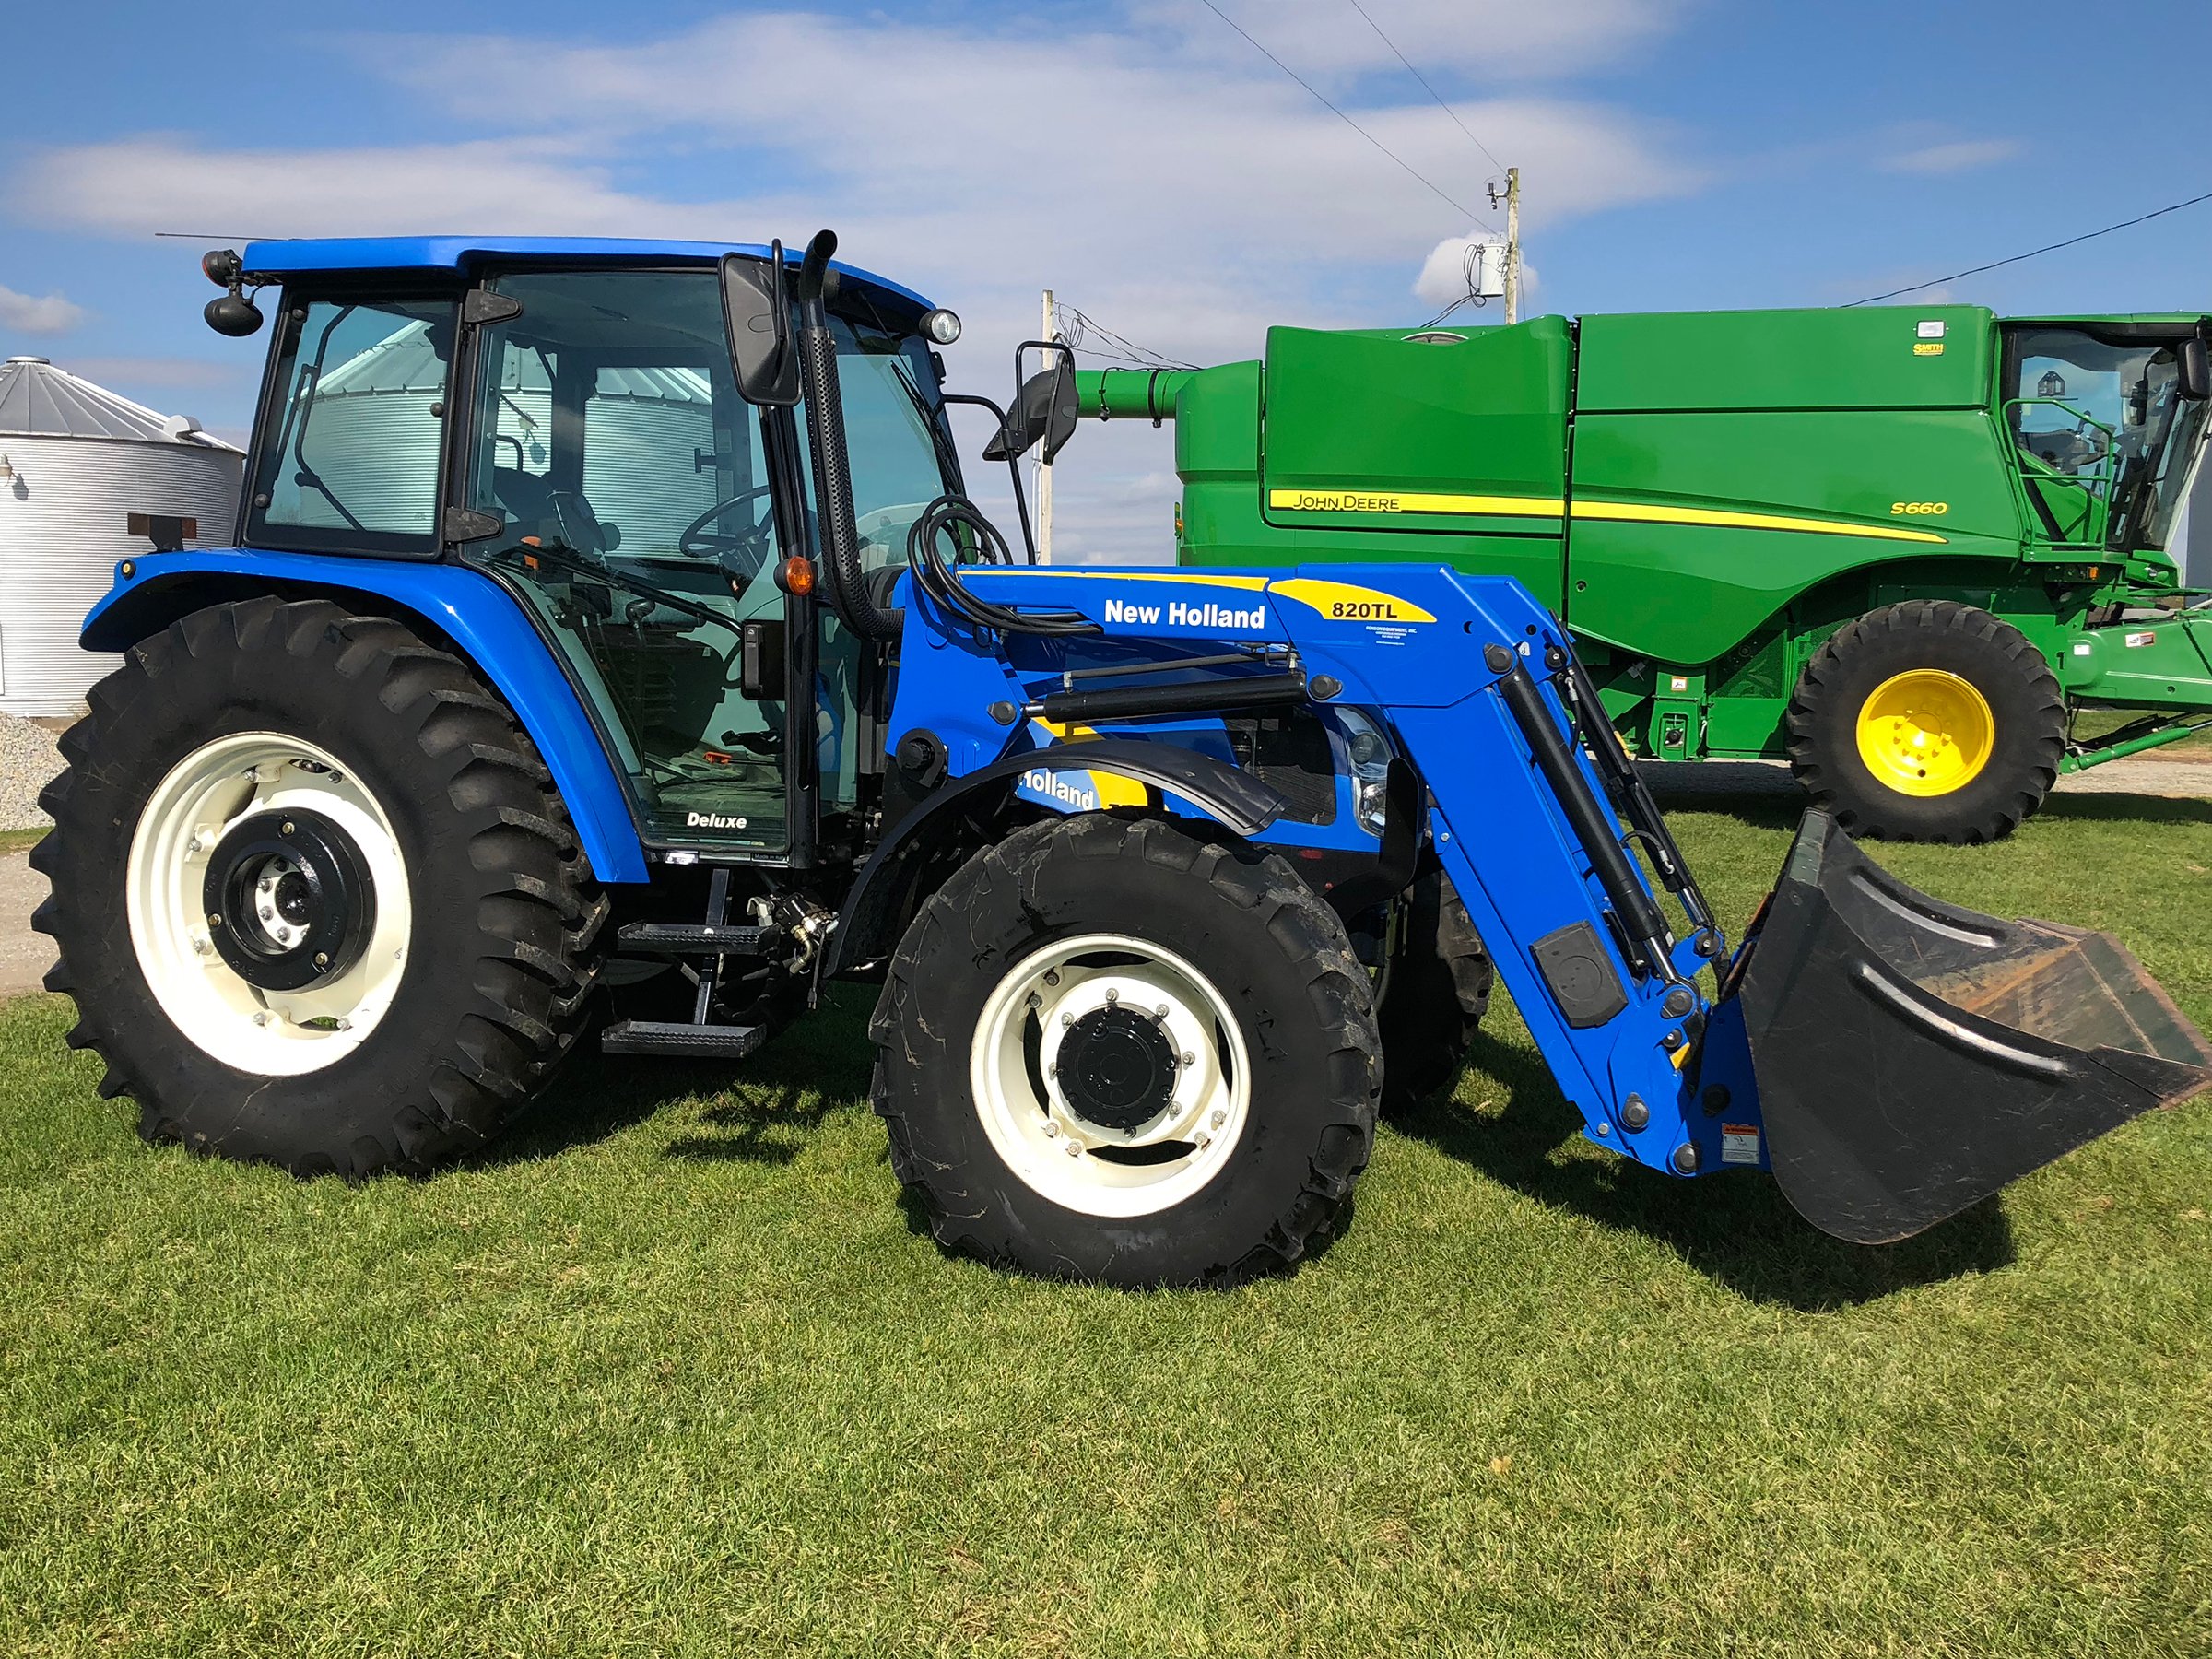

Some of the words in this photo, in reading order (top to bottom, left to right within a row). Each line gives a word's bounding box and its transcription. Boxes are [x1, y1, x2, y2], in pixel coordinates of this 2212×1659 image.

[1913, 343, 1944, 353] SMITH
[1293, 494, 1339, 509] JOHN
[1344, 495, 1400, 509] DEERE
[1890, 502, 1947, 514] S660
[1105, 599, 1161, 625] New
[1168, 602, 1265, 629] Holland
[1332, 602, 1398, 618] 820TL
[687, 812, 747, 829] Deluxe
